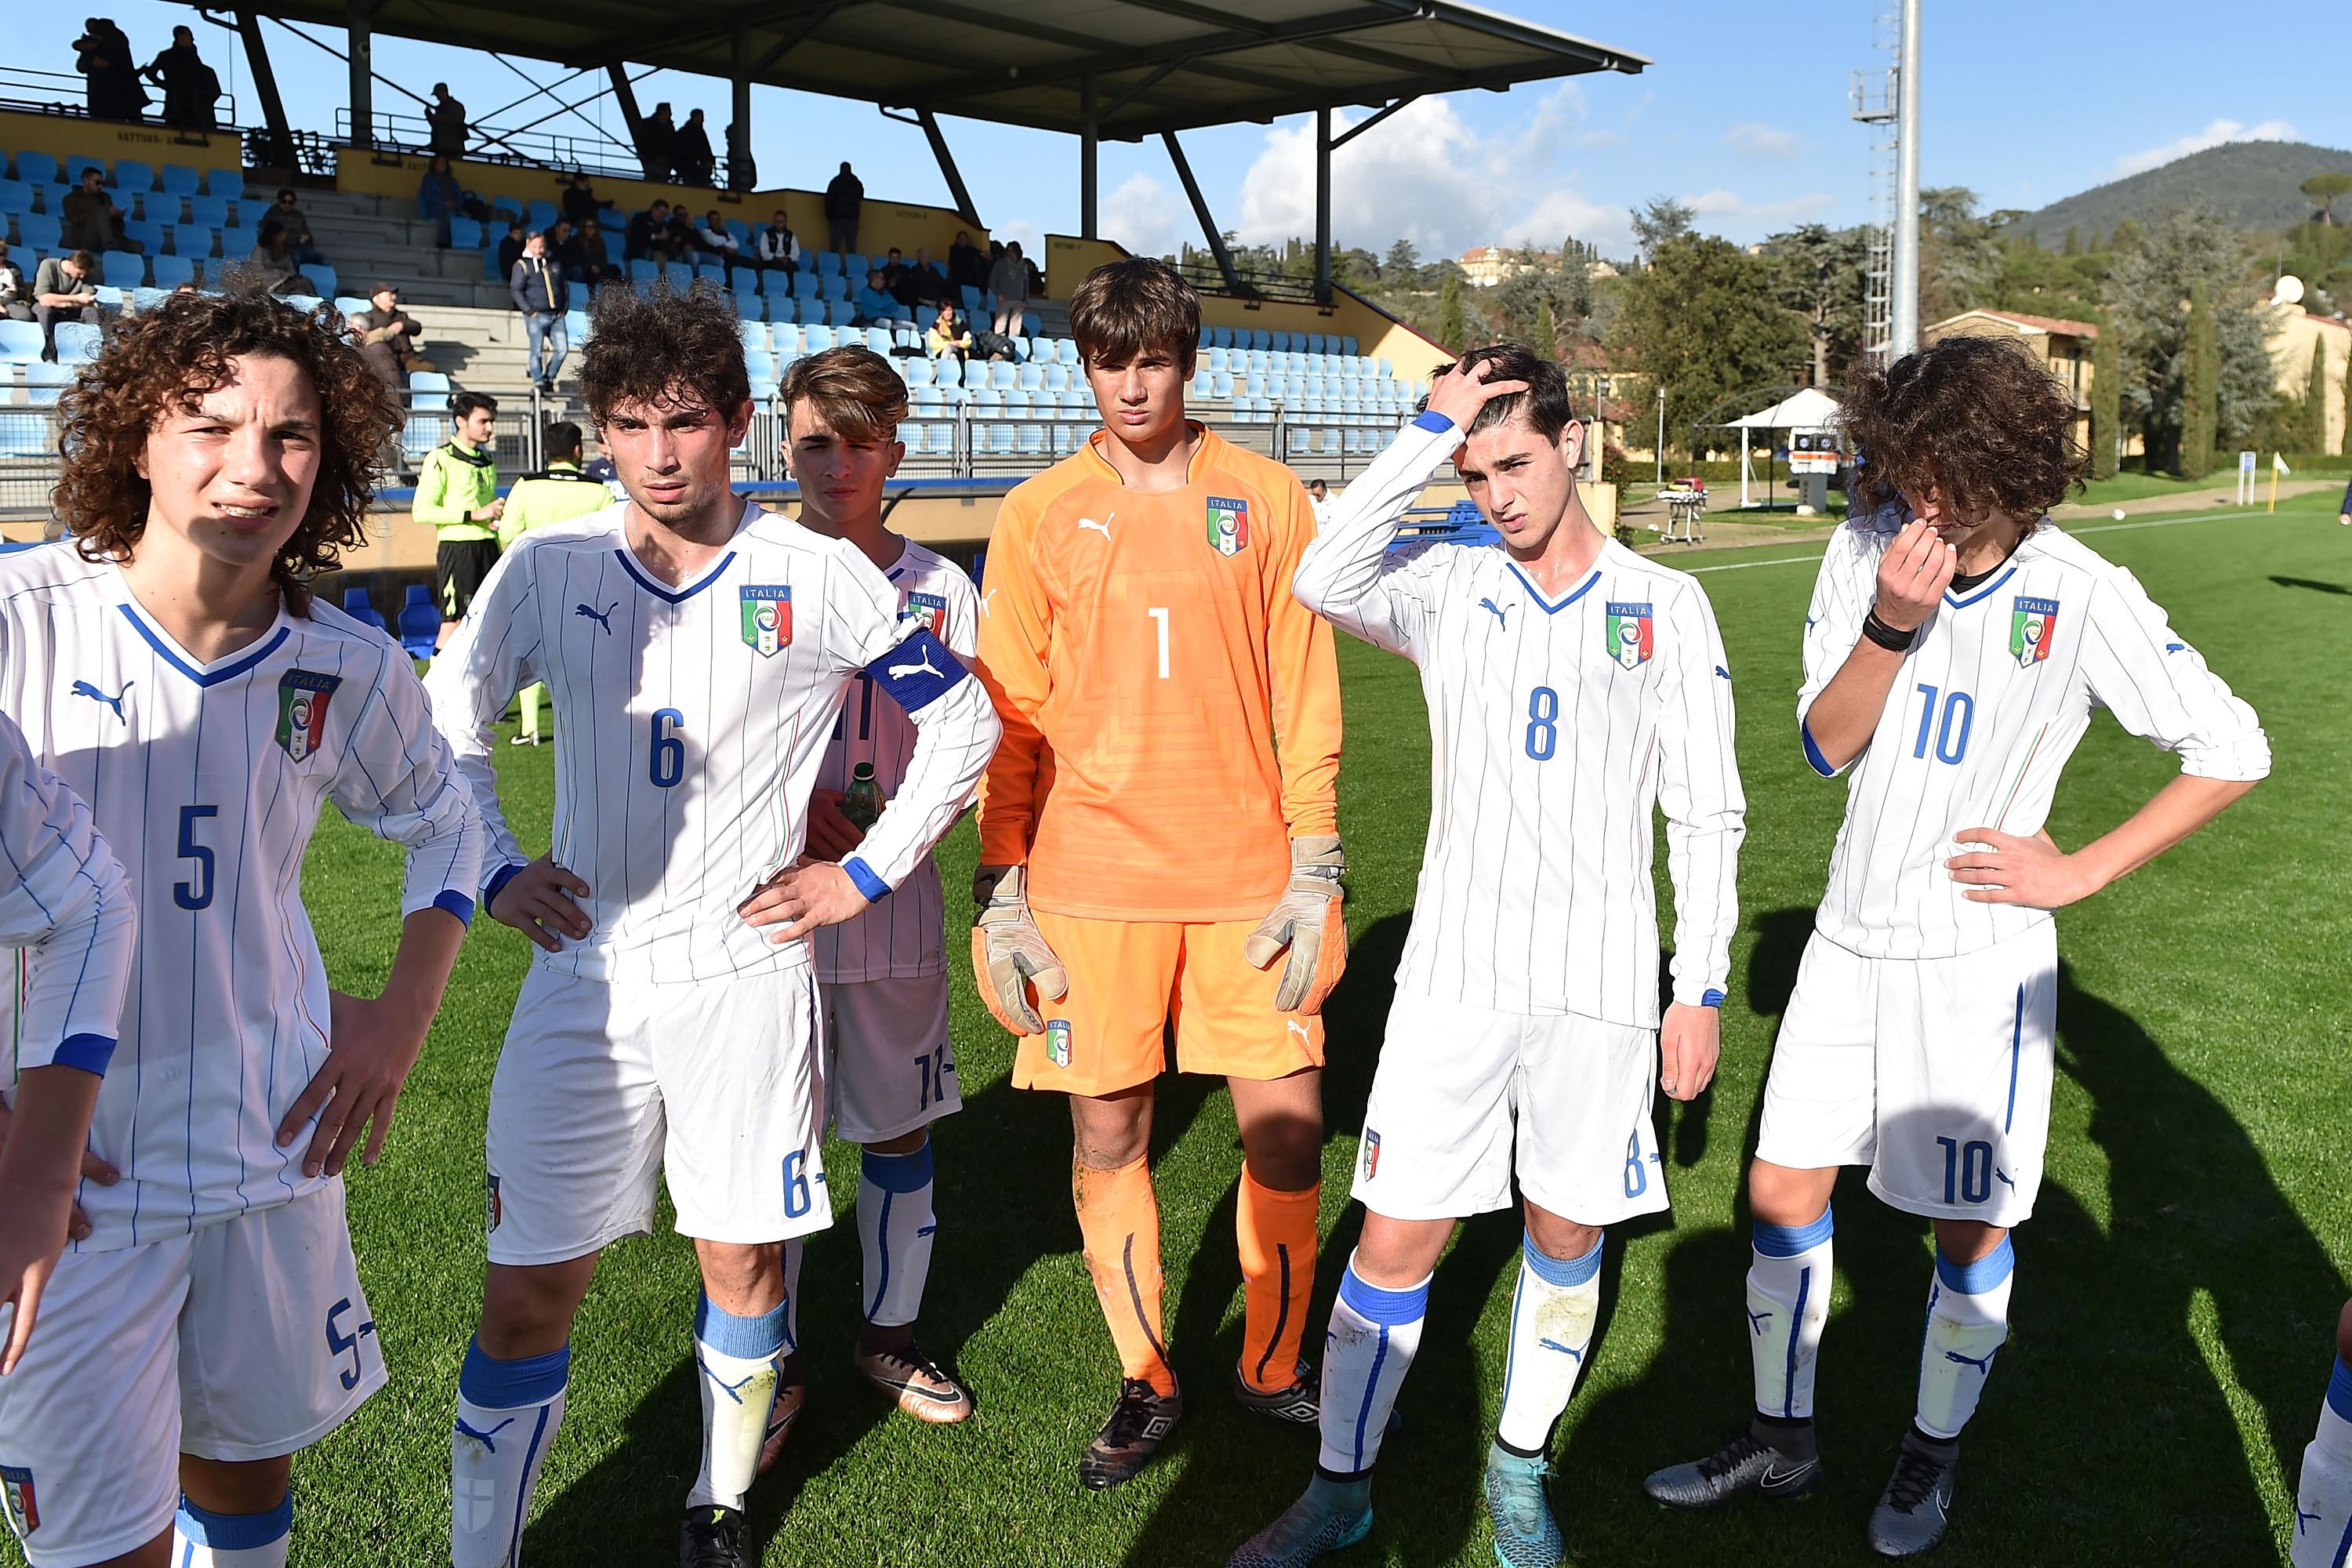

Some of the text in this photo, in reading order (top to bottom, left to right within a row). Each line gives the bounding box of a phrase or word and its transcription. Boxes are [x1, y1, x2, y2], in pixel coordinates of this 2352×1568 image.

[1210, 499, 1243, 510] ITALIA
[745, 589, 786, 598] ITALIA
[913, 595, 942, 608] ITALIA
[1610, 606, 1647, 615] ITALIA
[2019, 601, 2053, 612] ITALIA
[1148, 607, 1171, 679] 1
[287, 674, 330, 690] ITALIA
[649, 707, 685, 788] 6
[1525, 685, 1559, 761] 8
[1913, 682, 1974, 765] 10
[172, 804, 219, 911] 5
[914, 1043, 945, 1112] 11
[782, 1148, 811, 1219] 6
[1624, 1127, 1647, 1199] 8
[1936, 1134, 1993, 1205] 10
[325, 1297, 362, 1391] 5
